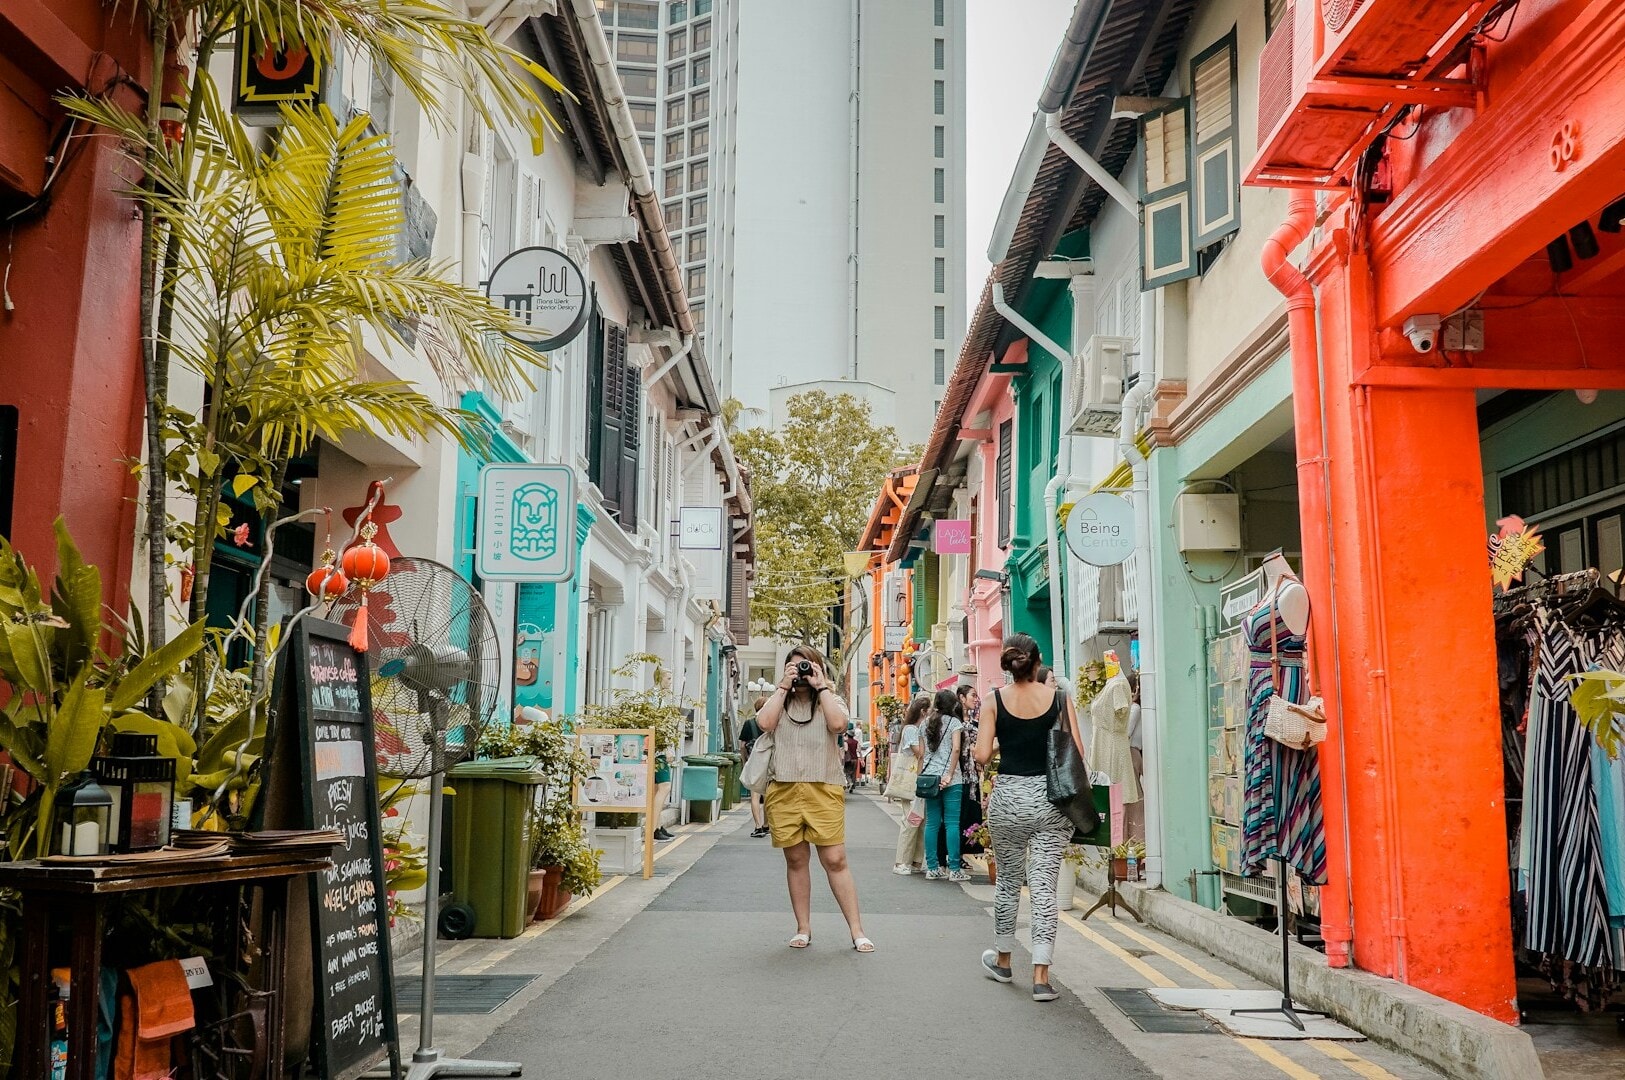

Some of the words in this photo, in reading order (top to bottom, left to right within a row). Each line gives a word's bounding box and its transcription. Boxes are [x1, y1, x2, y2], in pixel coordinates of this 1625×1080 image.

[1549, 119, 1574, 171] 68
[1080, 522, 1120, 537] Being
[1081, 535, 1129, 548] Centre
[172, 802, 180, 829] SERVED
[346, 815, 368, 851] juices
[184, 966, 206, 977] RVED
[327, 956, 339, 974] ANY
[331, 1011, 355, 1040] BEER
